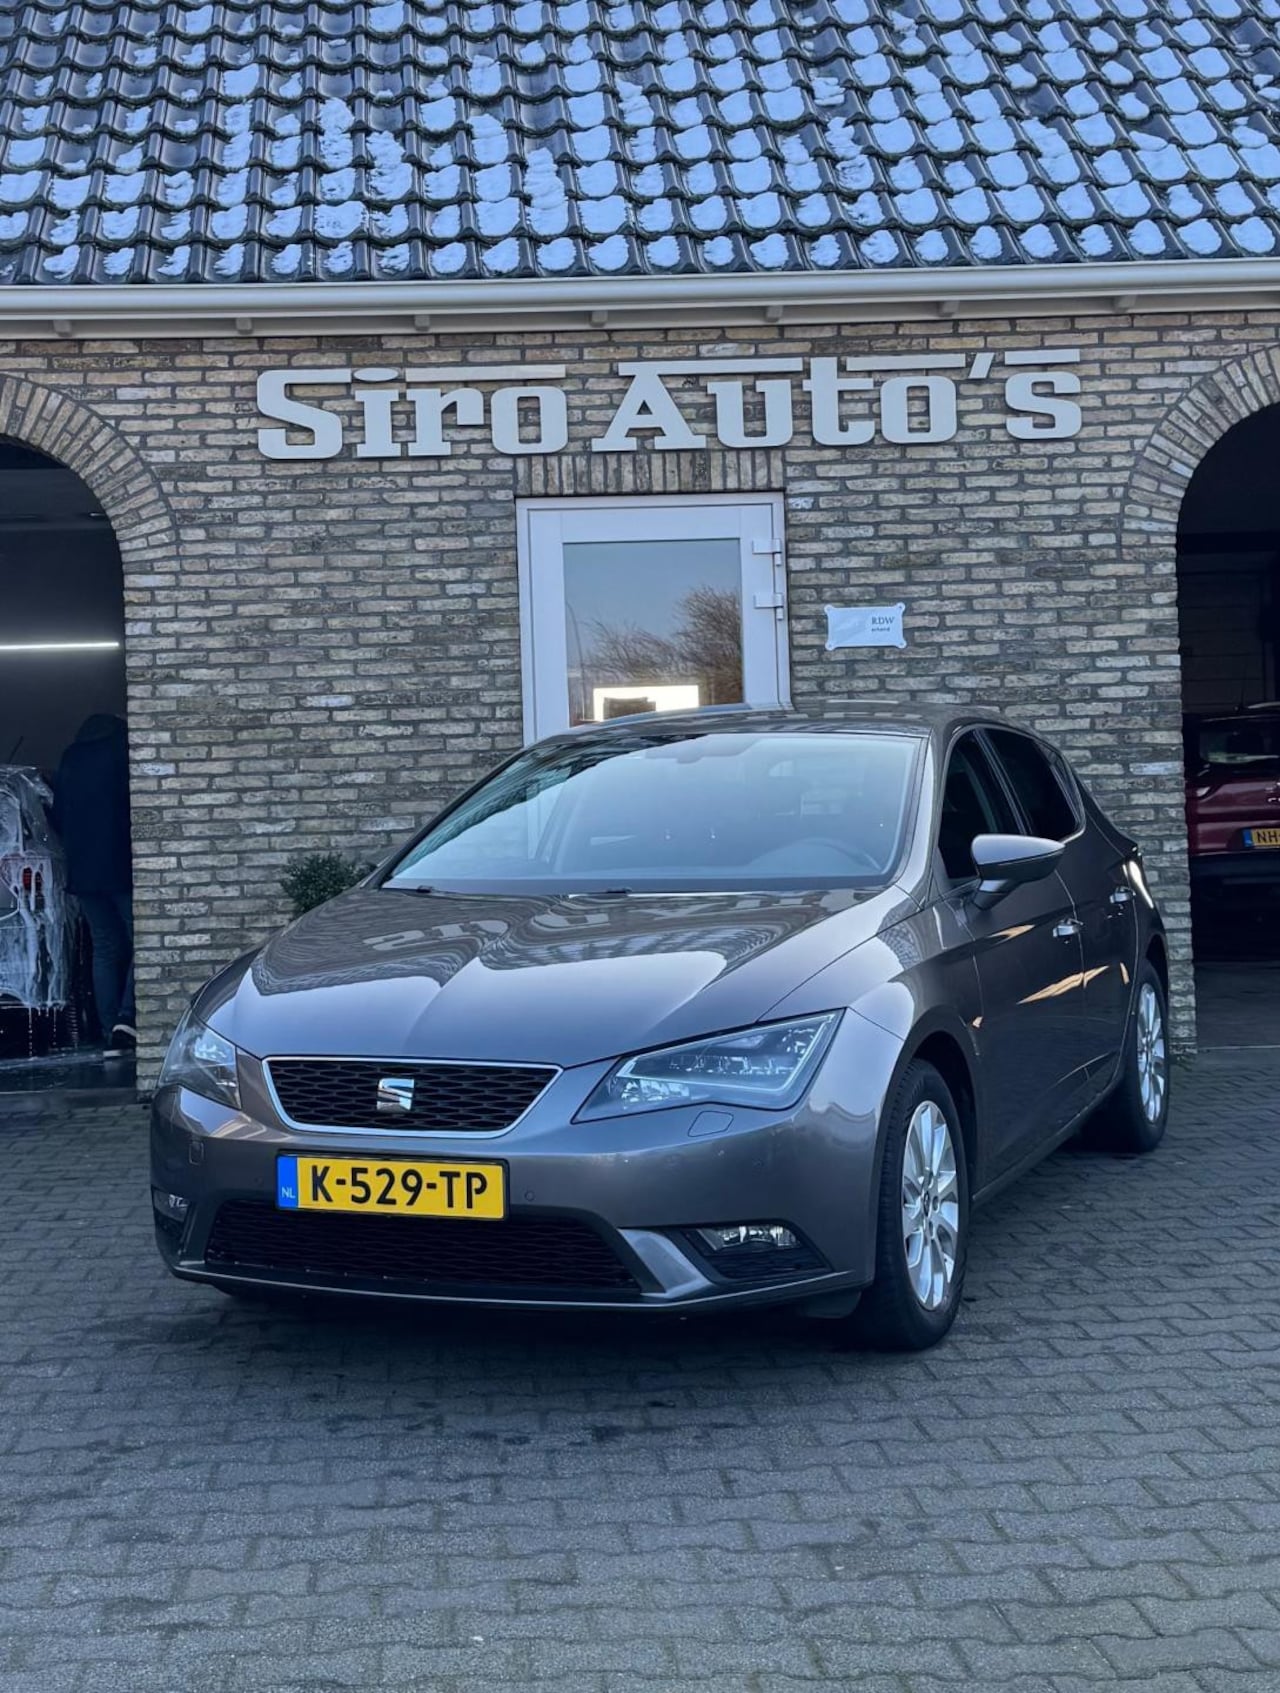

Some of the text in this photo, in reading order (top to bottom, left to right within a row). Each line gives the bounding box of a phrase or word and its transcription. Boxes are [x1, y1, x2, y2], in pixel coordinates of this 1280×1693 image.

[256, 349, 1082, 459] Siro Auto's
[281, 1165, 488, 1209] NL K-529-TP
